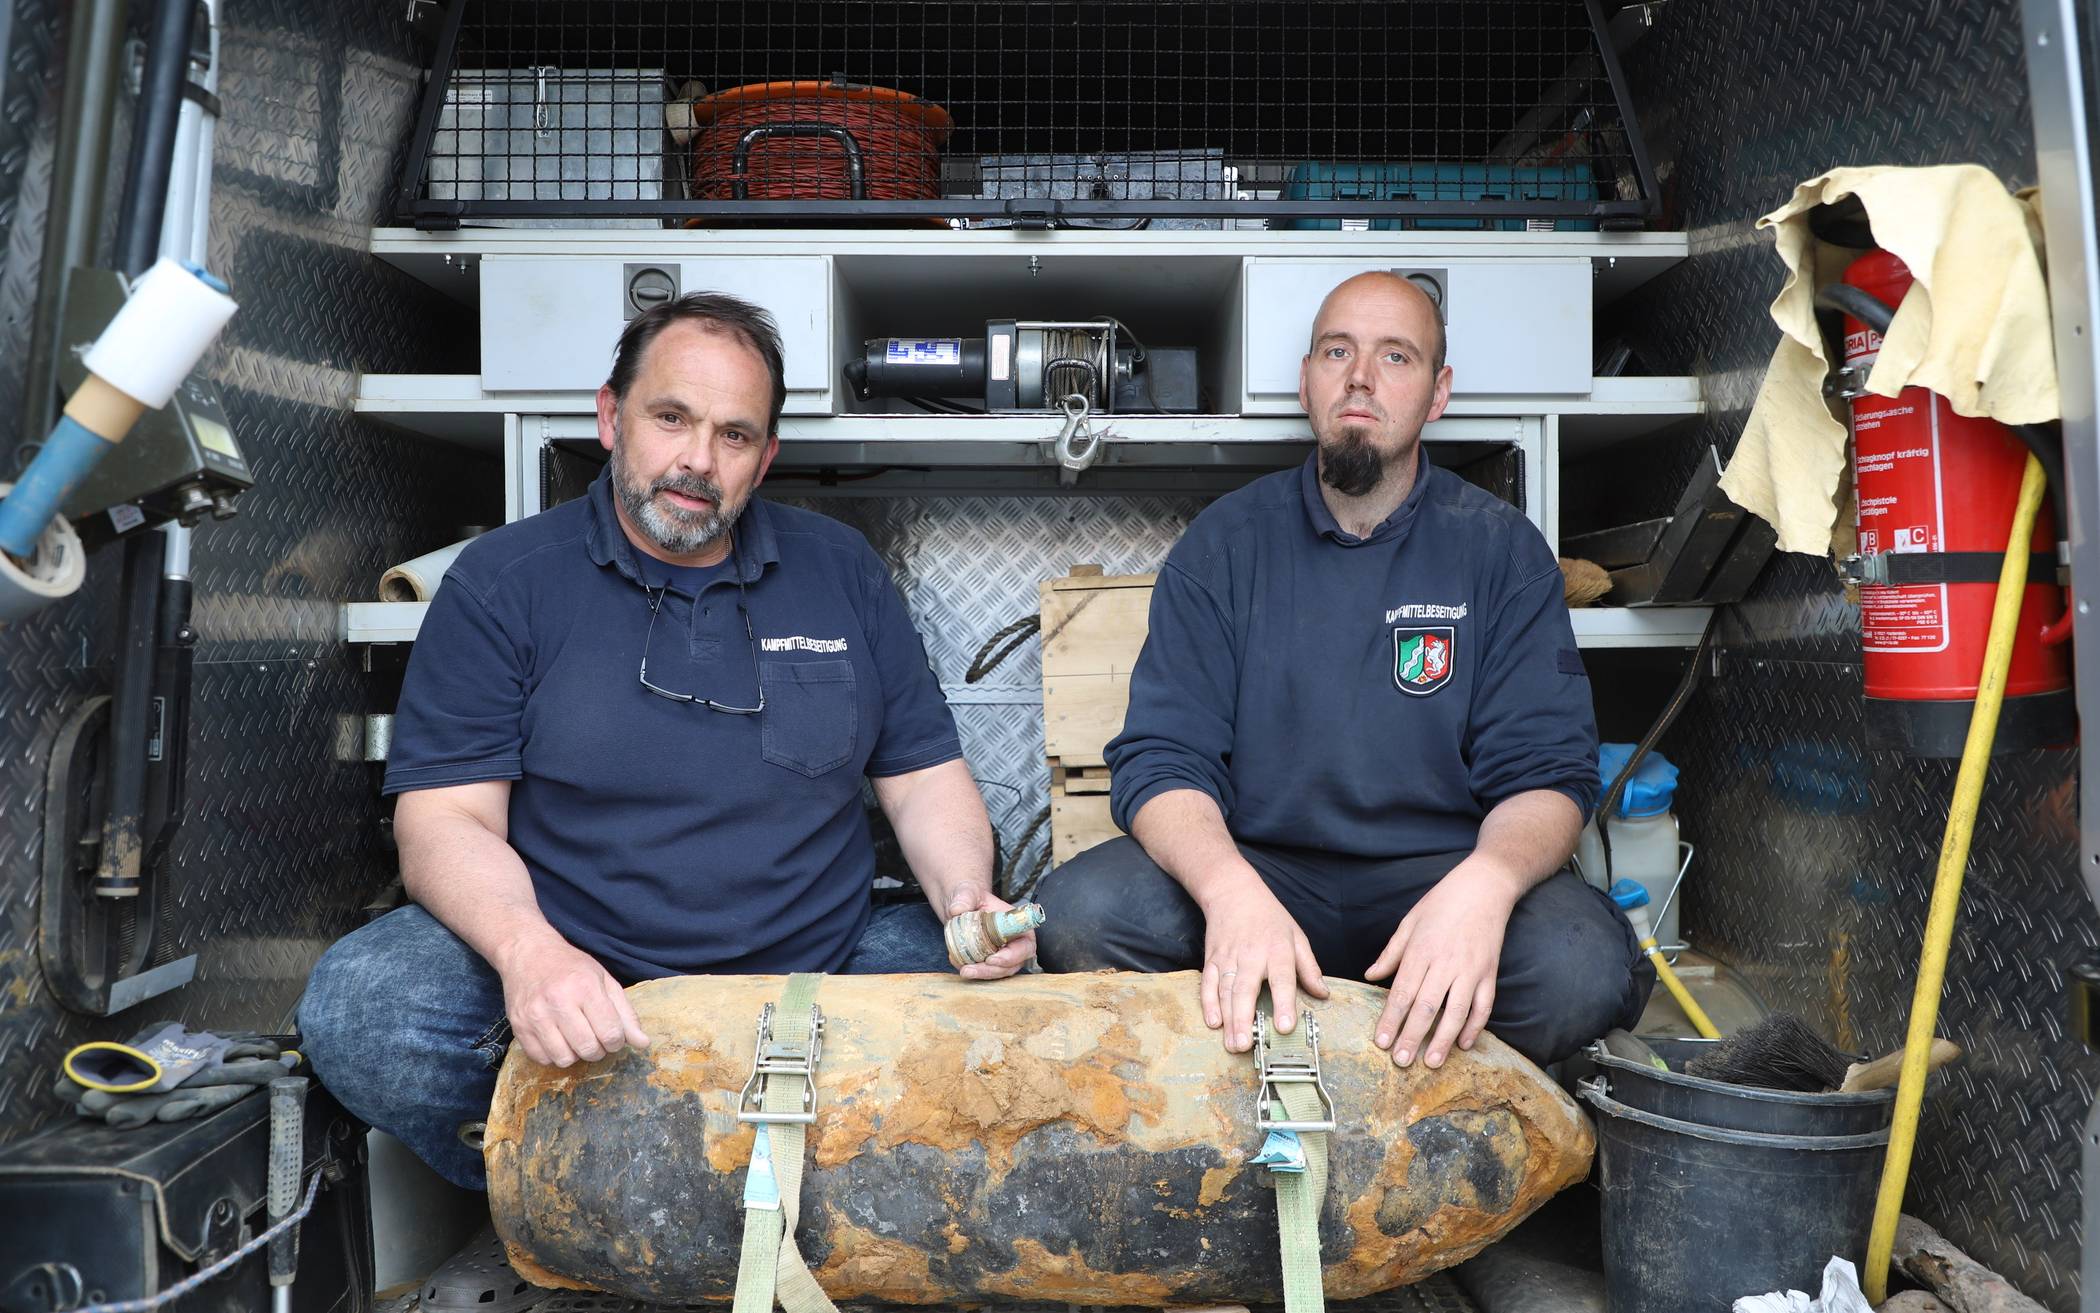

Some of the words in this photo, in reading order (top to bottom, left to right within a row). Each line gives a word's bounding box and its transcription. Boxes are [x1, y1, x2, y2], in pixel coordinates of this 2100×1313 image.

[1896, 448, 1930, 459] kräftig
[1868, 532, 1876, 546] B
[1912, 528, 1925, 543] C
[761, 636, 848, 653] KAMPFMITTELBESEITIGUNG
